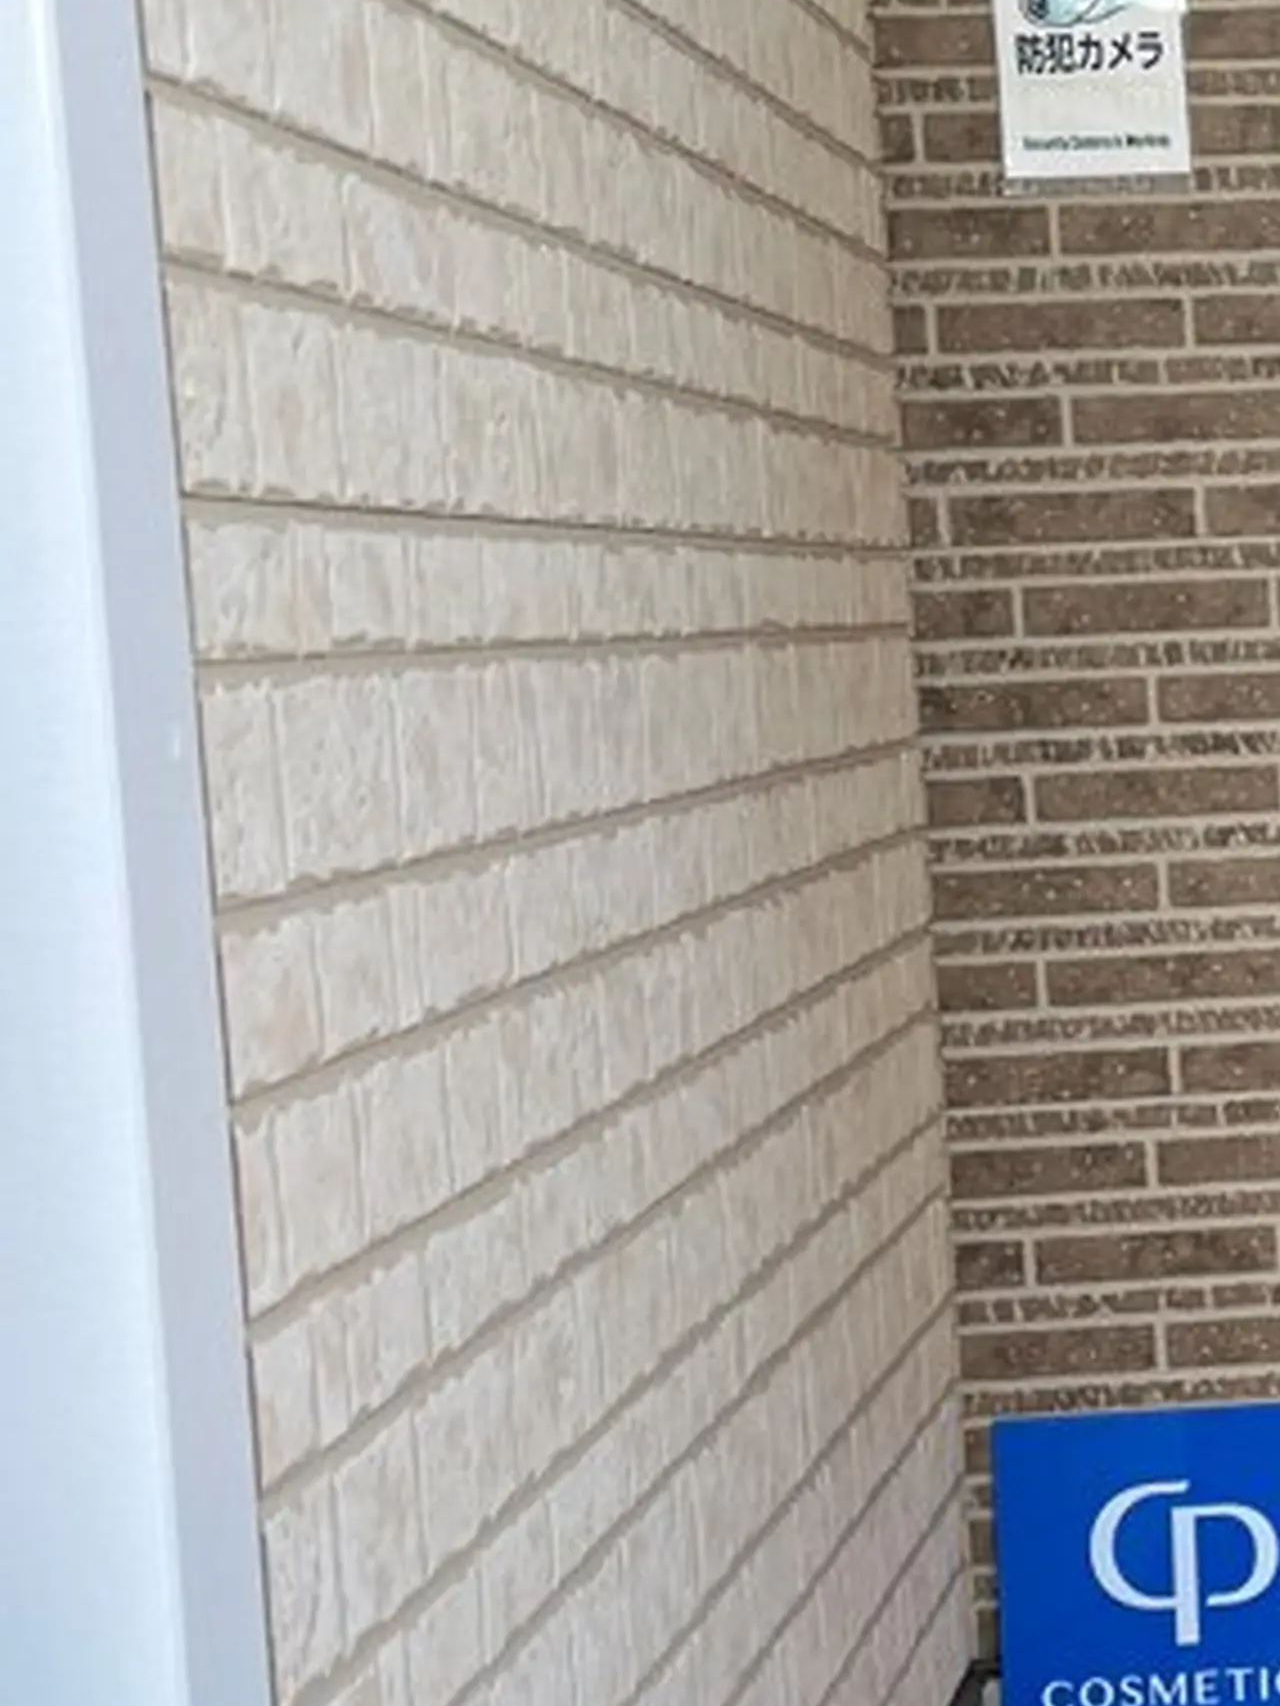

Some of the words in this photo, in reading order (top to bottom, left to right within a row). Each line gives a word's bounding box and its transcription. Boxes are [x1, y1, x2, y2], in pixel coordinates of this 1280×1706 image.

[1015, 31, 1164, 74] 防犯カメラ
